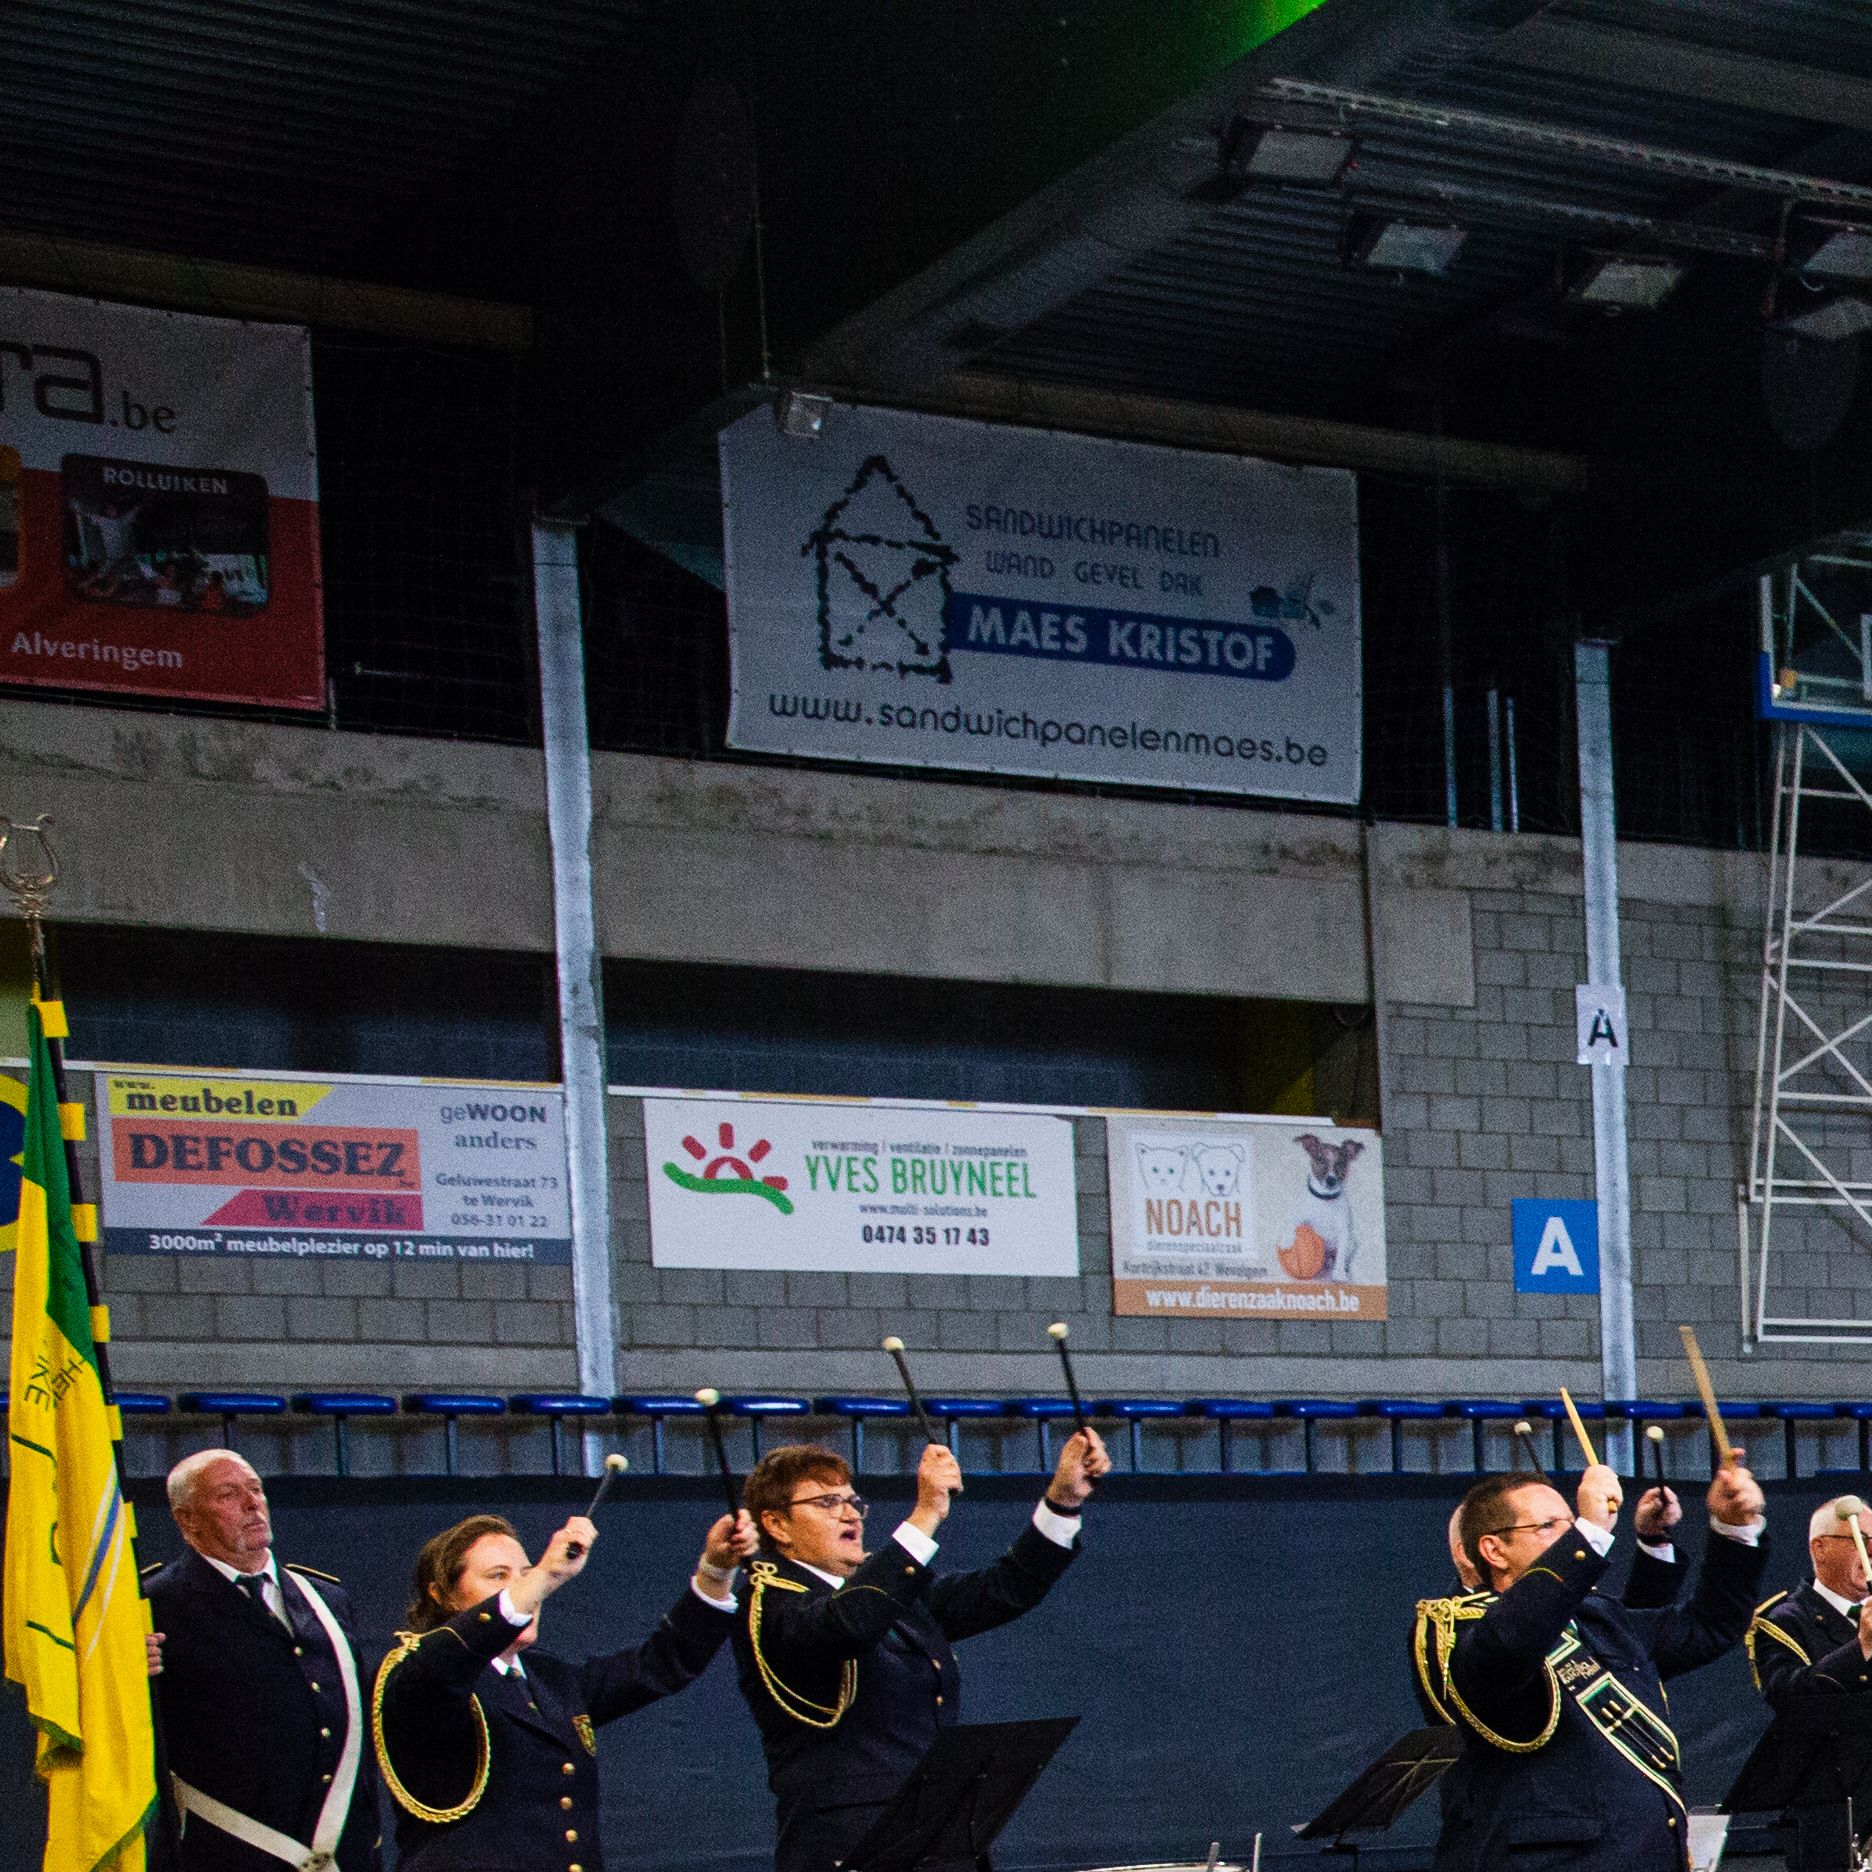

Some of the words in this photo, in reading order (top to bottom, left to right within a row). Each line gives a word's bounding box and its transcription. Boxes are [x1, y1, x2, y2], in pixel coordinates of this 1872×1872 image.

[103, 465, 228, 495] ROLLUIKEN
[986, 549, 1054, 579] WAND
[1073, 560, 1141, 591] GEVEL
[1160, 569, 1203, 597] DAK
[11, 632, 183, 670] Alveringem
[967, 604, 1088, 653] MAES
[1108, 618, 1274, 672] KRISTOF
[769, 692, 1329, 767] www.sandwichpanelenmaes.be
[1587, 1008, 1619, 1049] A
[126, 1088, 299, 1117] meubelen
[439, 1102, 547, 1124] geWOON
[129, 1132, 406, 1178] DEFOSSEZ
[453, 1130, 537, 1150] anders
[804, 1154, 879, 1194] YVES
[891, 1157, 1037, 1199] BRUYNEEL
[264, 1194, 407, 1226] Wervik
[463, 1195, 480, 1206] te
[483, 1194, 535, 1208] Wervik
[1145, 1198, 1243, 1238] NOACH
[226, 1236, 361, 1256] meubelplezier
[364, 1243, 390, 1258] op
[393, 1241, 415, 1256] 12
[419, 1242, 453, 1257] min
[457, 1244, 490, 1257] van
[862, 1224, 907, 1244] 0474
[913, 1226, 937, 1245] 35
[944, 1227, 961, 1246] 17
[966, 1227, 990, 1247] 43
[1531, 1217, 1584, 1276] A
[1146, 1285, 1360, 1312] www.dierenzaaknoach.be
